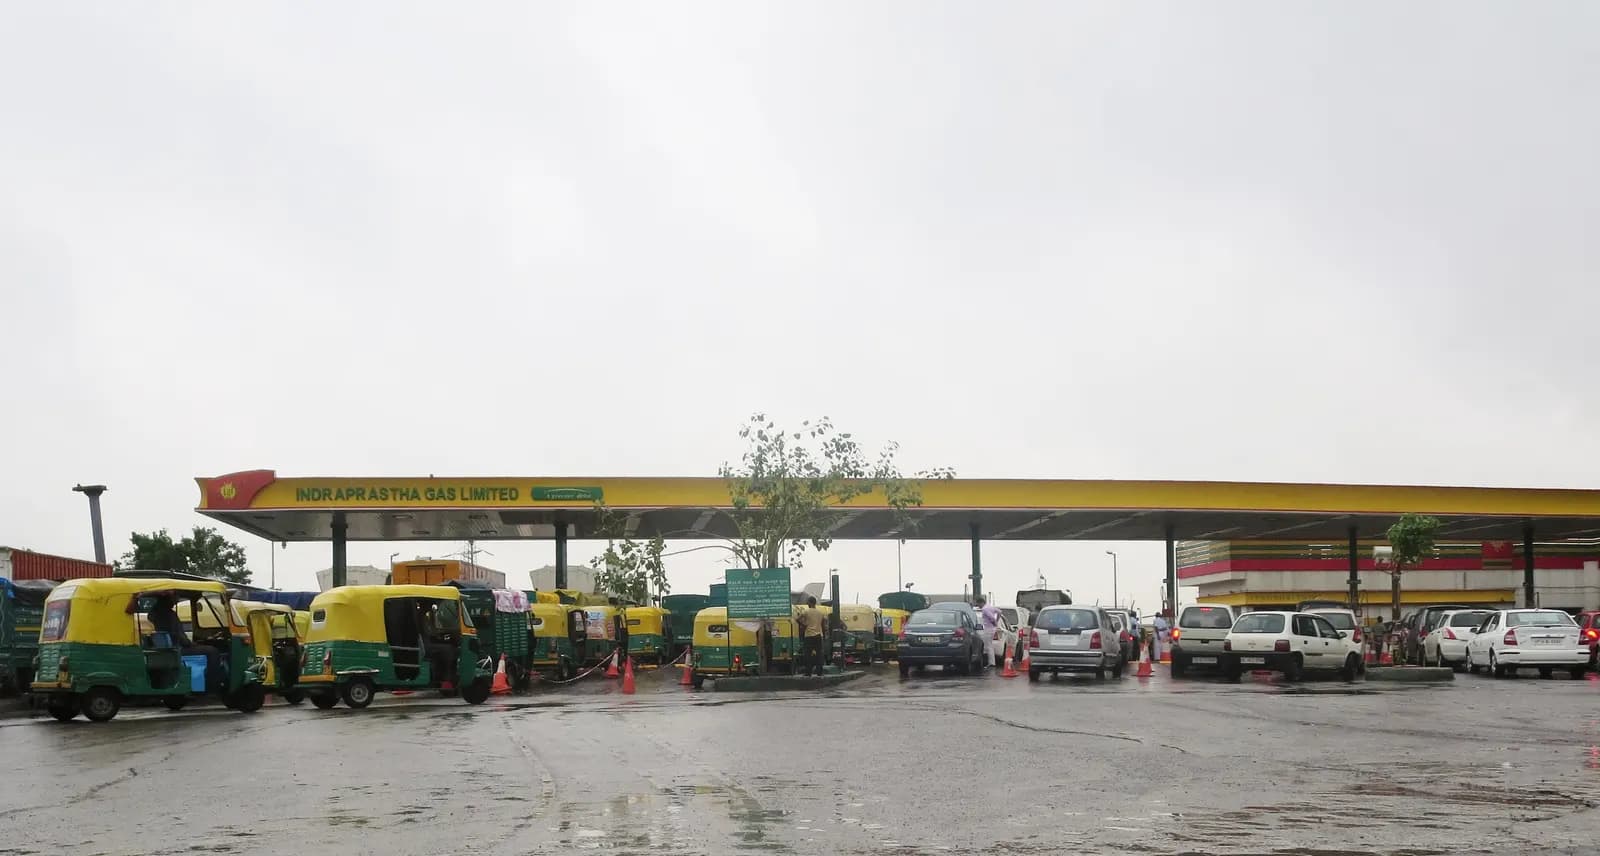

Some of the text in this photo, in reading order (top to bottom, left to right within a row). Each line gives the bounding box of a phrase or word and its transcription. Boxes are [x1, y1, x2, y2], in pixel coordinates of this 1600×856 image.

[296, 487, 519, 502] INDRAPRASTHA GAS LIMITED
